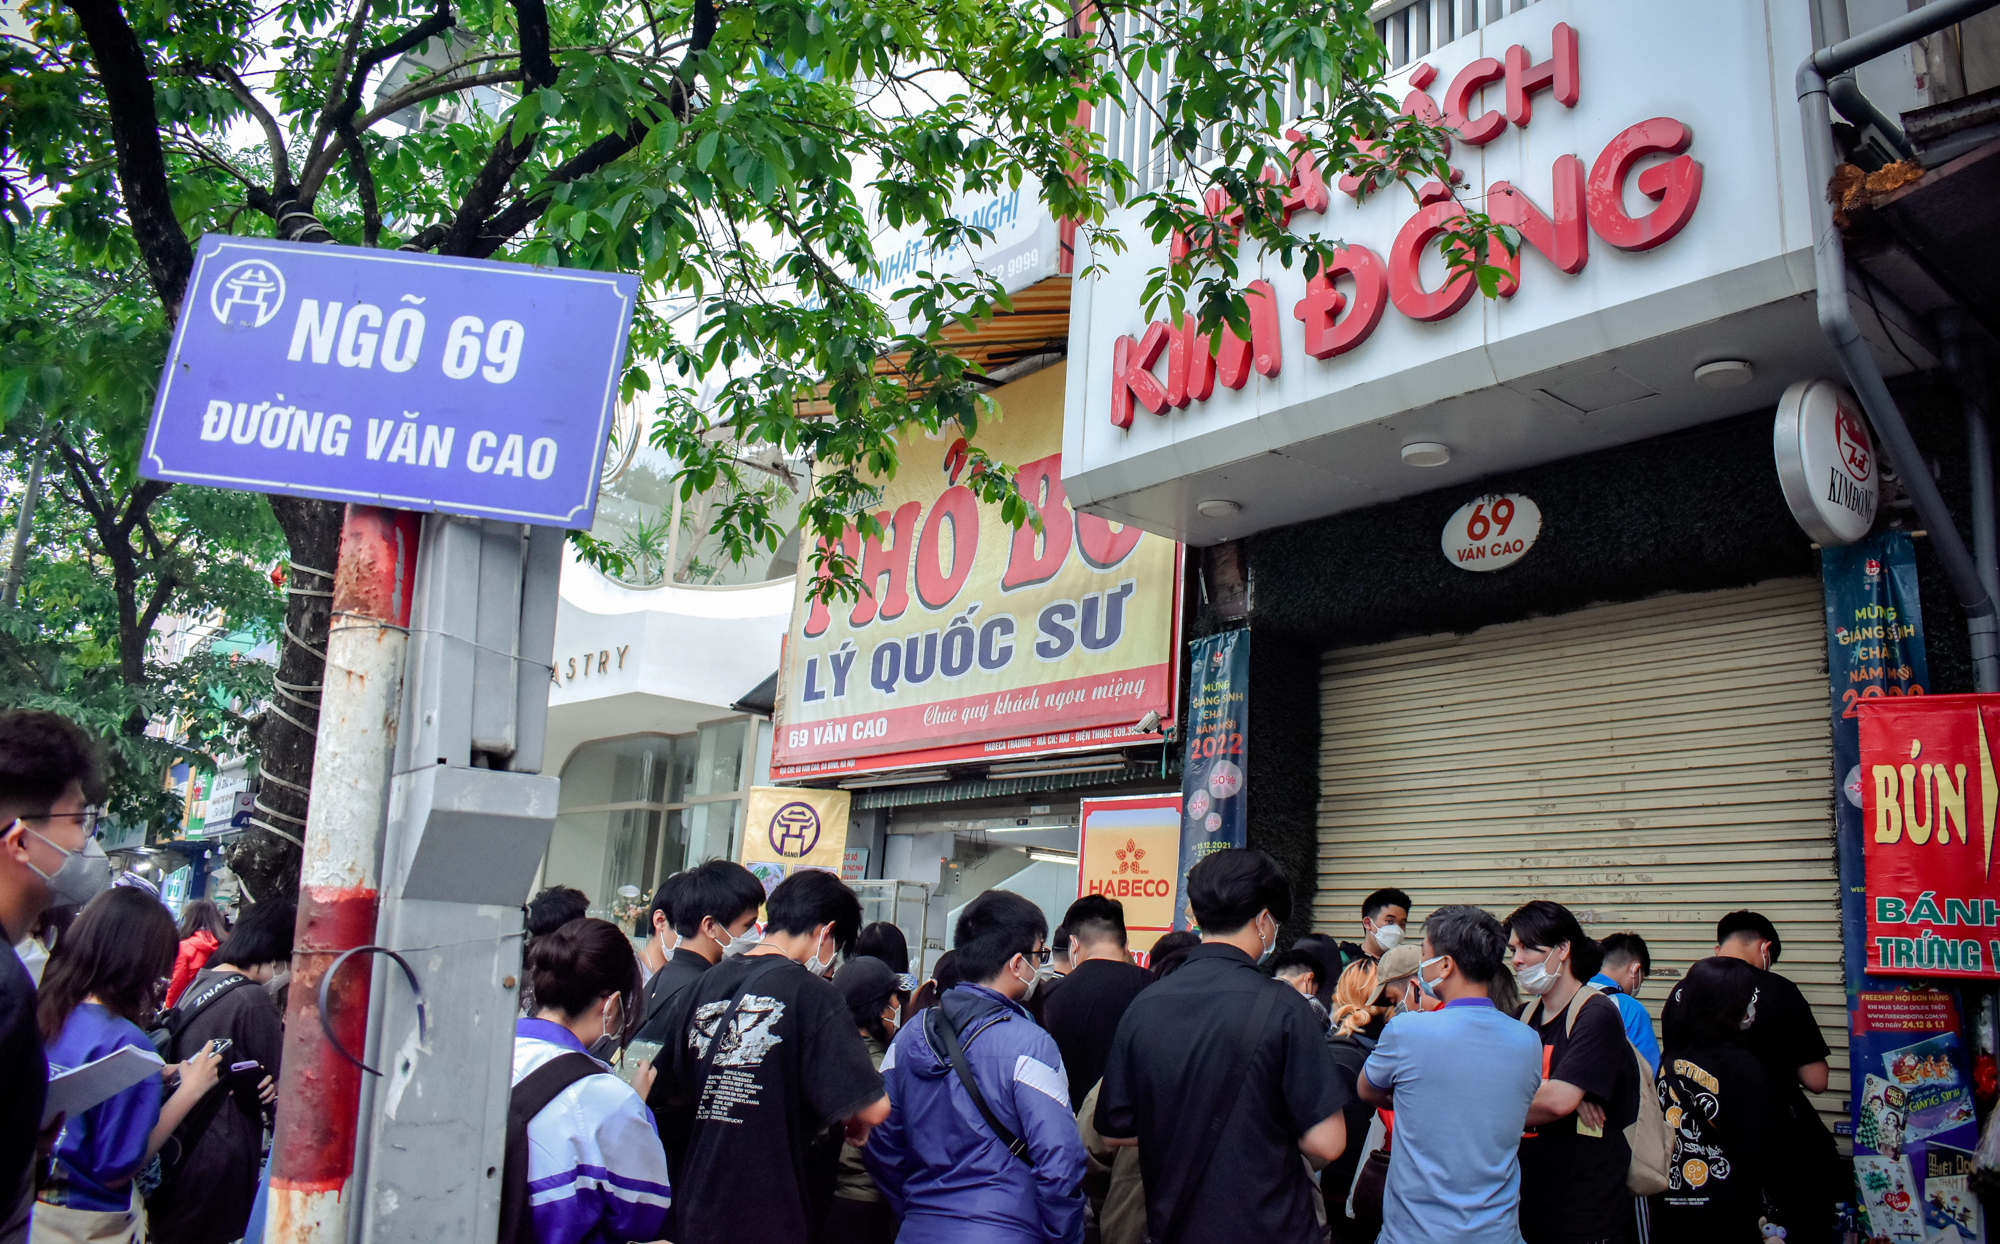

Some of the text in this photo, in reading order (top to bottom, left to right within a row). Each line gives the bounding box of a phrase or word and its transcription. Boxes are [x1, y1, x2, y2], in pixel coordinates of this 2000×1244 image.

[972, 188, 1020, 230] NGHỊ
[875, 239, 923, 290] NHẬT
[1007, 248, 1039, 277] 9999
[1111, 117, 1702, 428] KIM ĐỒNG
[287, 294, 525, 385] NGÕ 69
[200, 392, 558, 481] ĐƯỜNG VĂN CAO
[1467, 498, 1515, 541] 69
[1457, 539, 1524, 562] VĂN CAO
[1855, 603, 1897, 621] MỪNG
[802, 582, 1134, 702] LÝ QUỐC SƯ
[1839, 625, 1885, 645] GIÁNG
[1202, 680, 1230, 693] MỪNG
[1850, 665, 1883, 683] NĂM
[923, 677, 1146, 727] Chúc quý khách ngon miệng
[789, 717, 887, 748] 69 VĂN CAO
[1191, 733, 1243, 760] 2022
[1872, 739, 1968, 845] BÚN
[1089, 879, 1170, 898] HABECO
[1875, 929, 1983, 972] TRỨNG
[1895, 994, 1910, 1003] MỌI
[1928, 993, 1949, 1001] HÀNG
[1909, 1095, 1939, 1112] GIÁNG
